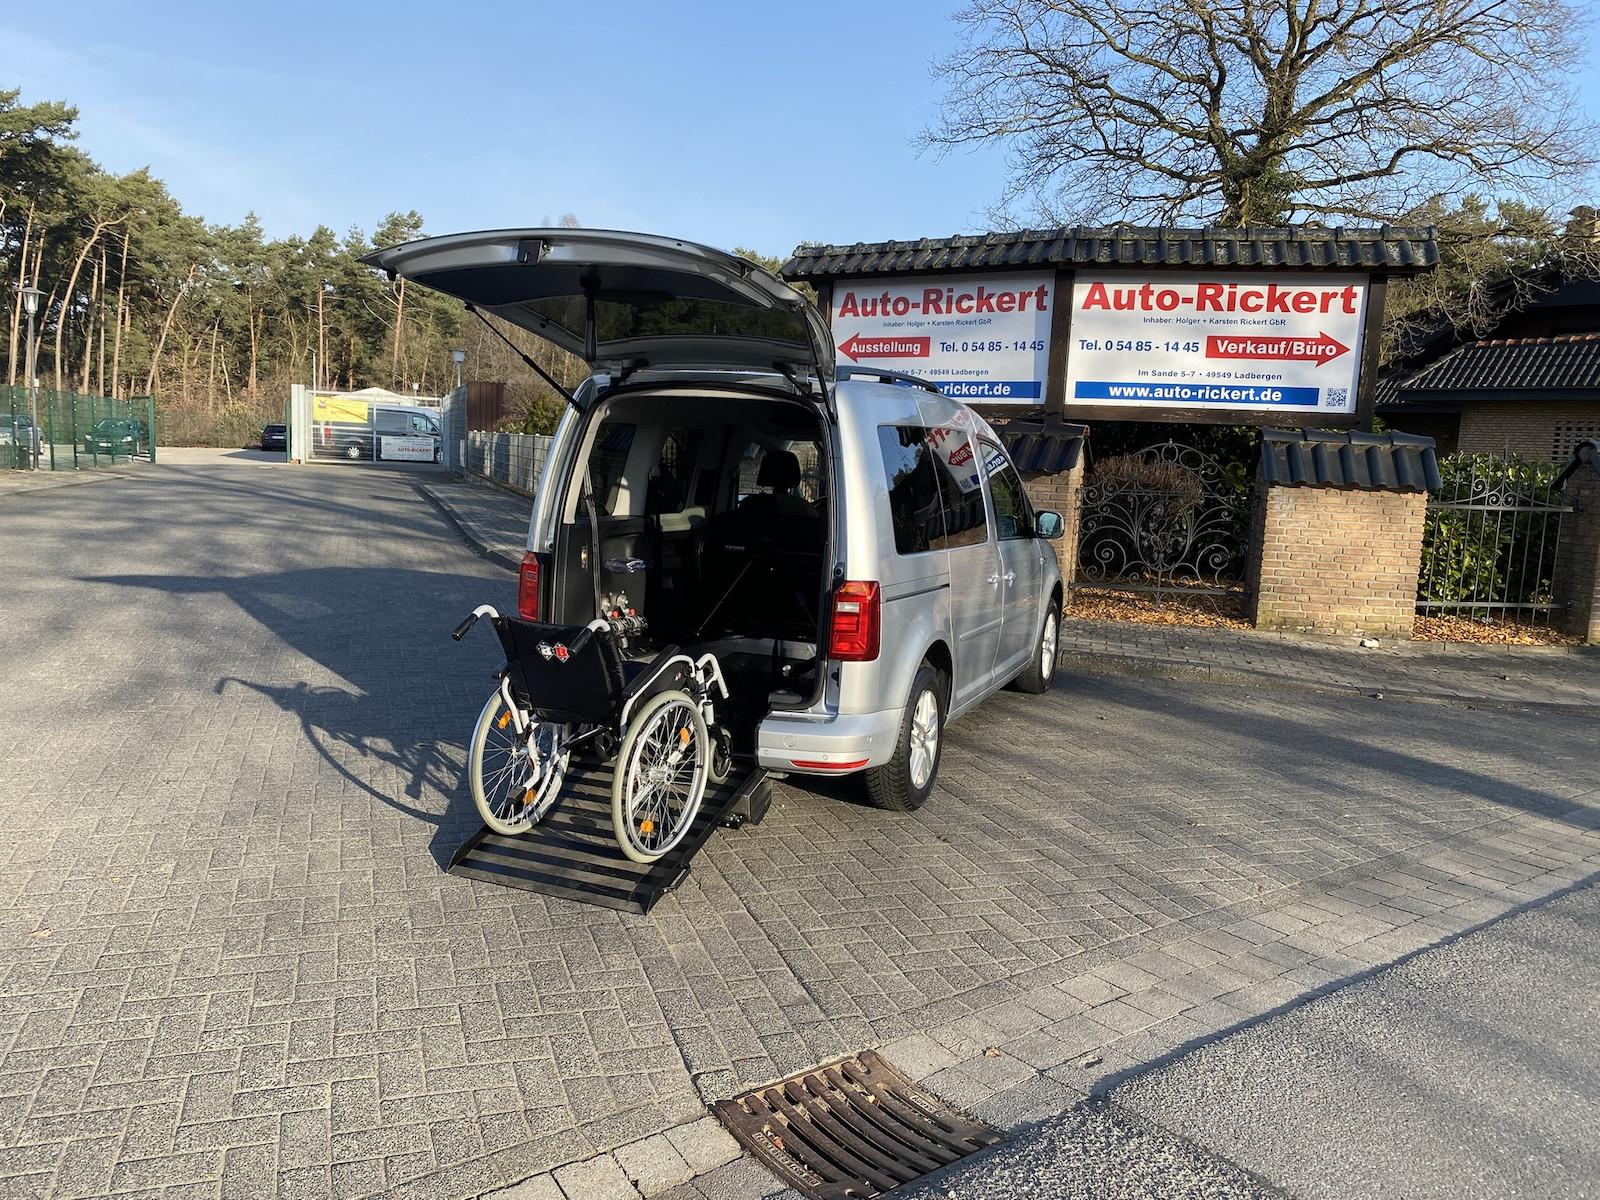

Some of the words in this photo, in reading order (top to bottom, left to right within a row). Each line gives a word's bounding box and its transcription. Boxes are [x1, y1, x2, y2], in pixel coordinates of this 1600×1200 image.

[839, 284, 1048, 317] Auto-Rickert
[1082, 282, 1357, 314] Auto-Rickert
[907, 320, 925, 328] Holger
[1176, 317, 1200, 325] Holger
[850, 342, 921, 355] Ausstellung
[940, 342, 958, 352] Tel.
[962, 342, 968, 351] 0
[971, 342, 985, 351] 54
[988, 341, 1002, 351] 85
[1014, 341, 1026, 351] 14
[1030, 341, 1044, 351] 45
[1079, 340, 1101, 350] Tel.
[1105, 340, 1113, 351] 0
[1116, 341, 1132, 351] 54
[1135, 341, 1152, 351] 85
[1164, 342, 1179, 352] 14
[1183, 342, 1200, 352] 45
[1217, 340, 1337, 356] Verkauf/Büro
[1234, 372, 1282, 381] Ladbergen
[940, 383, 1011, 395] -rickert.de
[1109, 385, 1282, 401] www.auto-rickert.de
